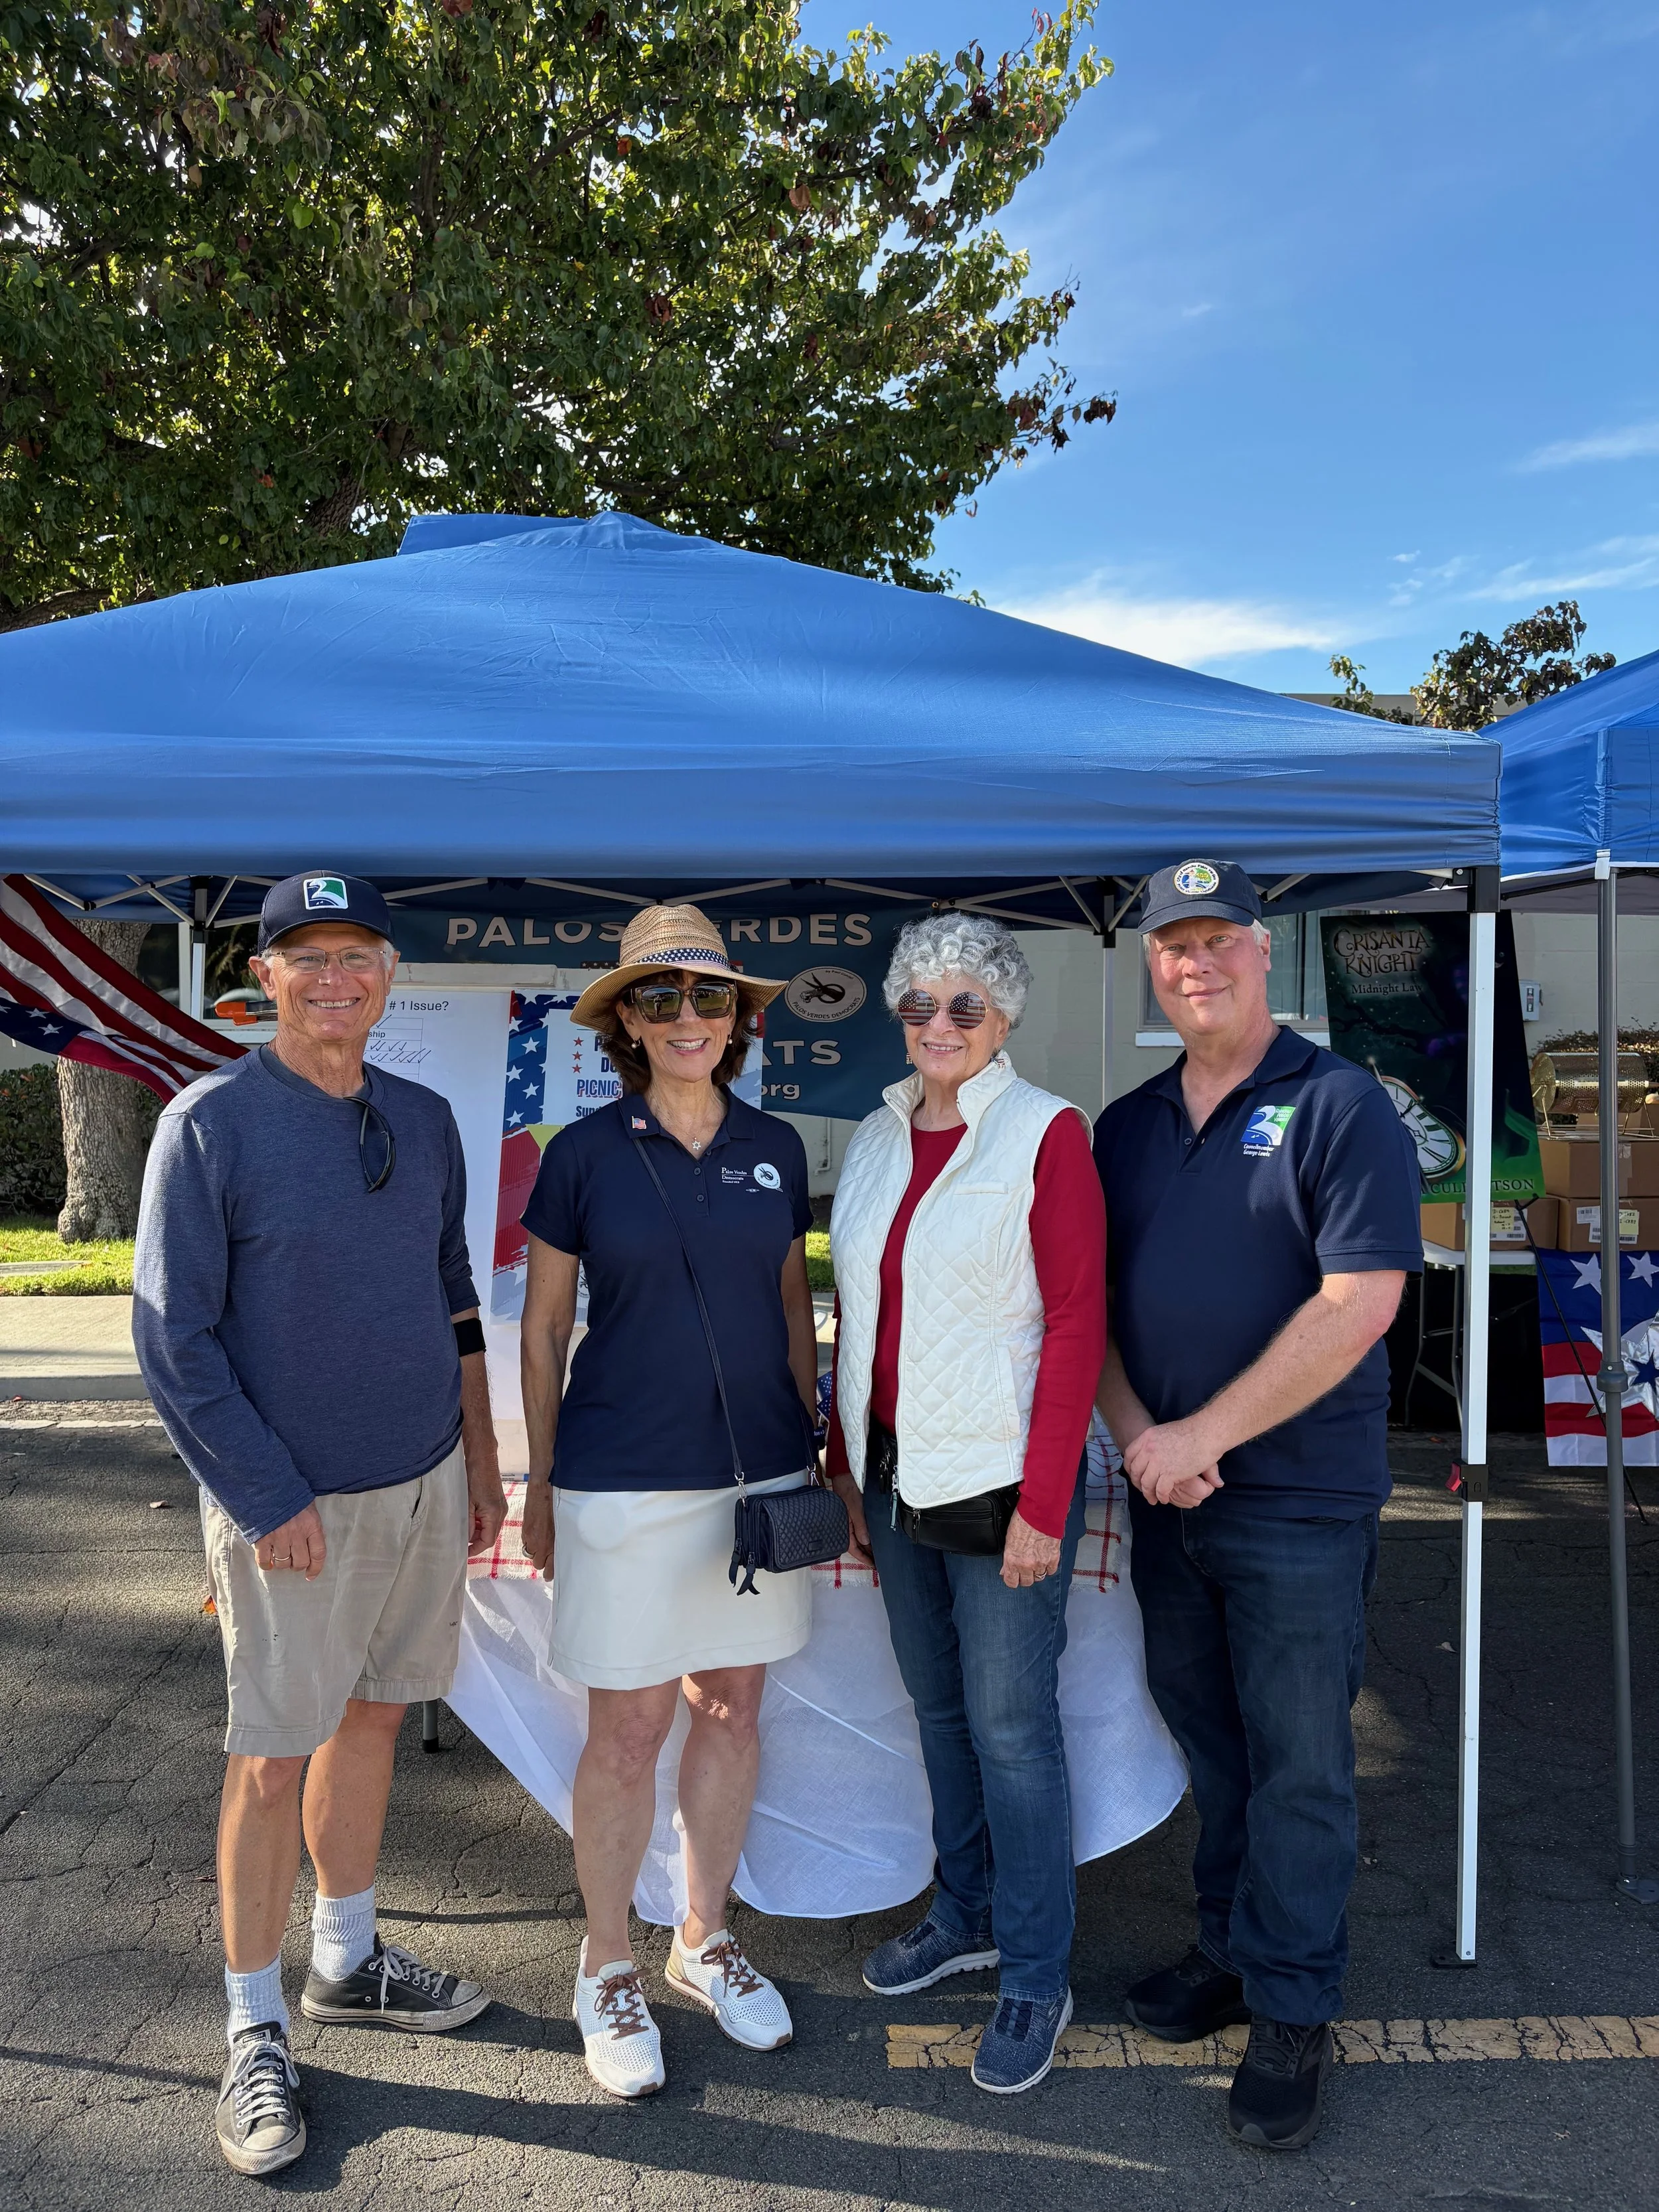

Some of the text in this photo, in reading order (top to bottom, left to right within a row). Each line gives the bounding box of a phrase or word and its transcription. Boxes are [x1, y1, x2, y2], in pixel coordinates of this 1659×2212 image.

[446, 913, 873, 947] PALOS RDES
[1333, 928, 1431, 957] CRISANTA
[1344, 951, 1421, 978] KNIGHT
[1352, 983, 1423, 995] Midnight Law
[400, 1001, 405, 1010] 1
[410, 1000, 449, 1011] Issue?
[792, 1001, 807, 1014] PALOS
[831, 997, 861, 1018] DEMOCRATS
[577, 1079, 622, 1098] PICNIC
